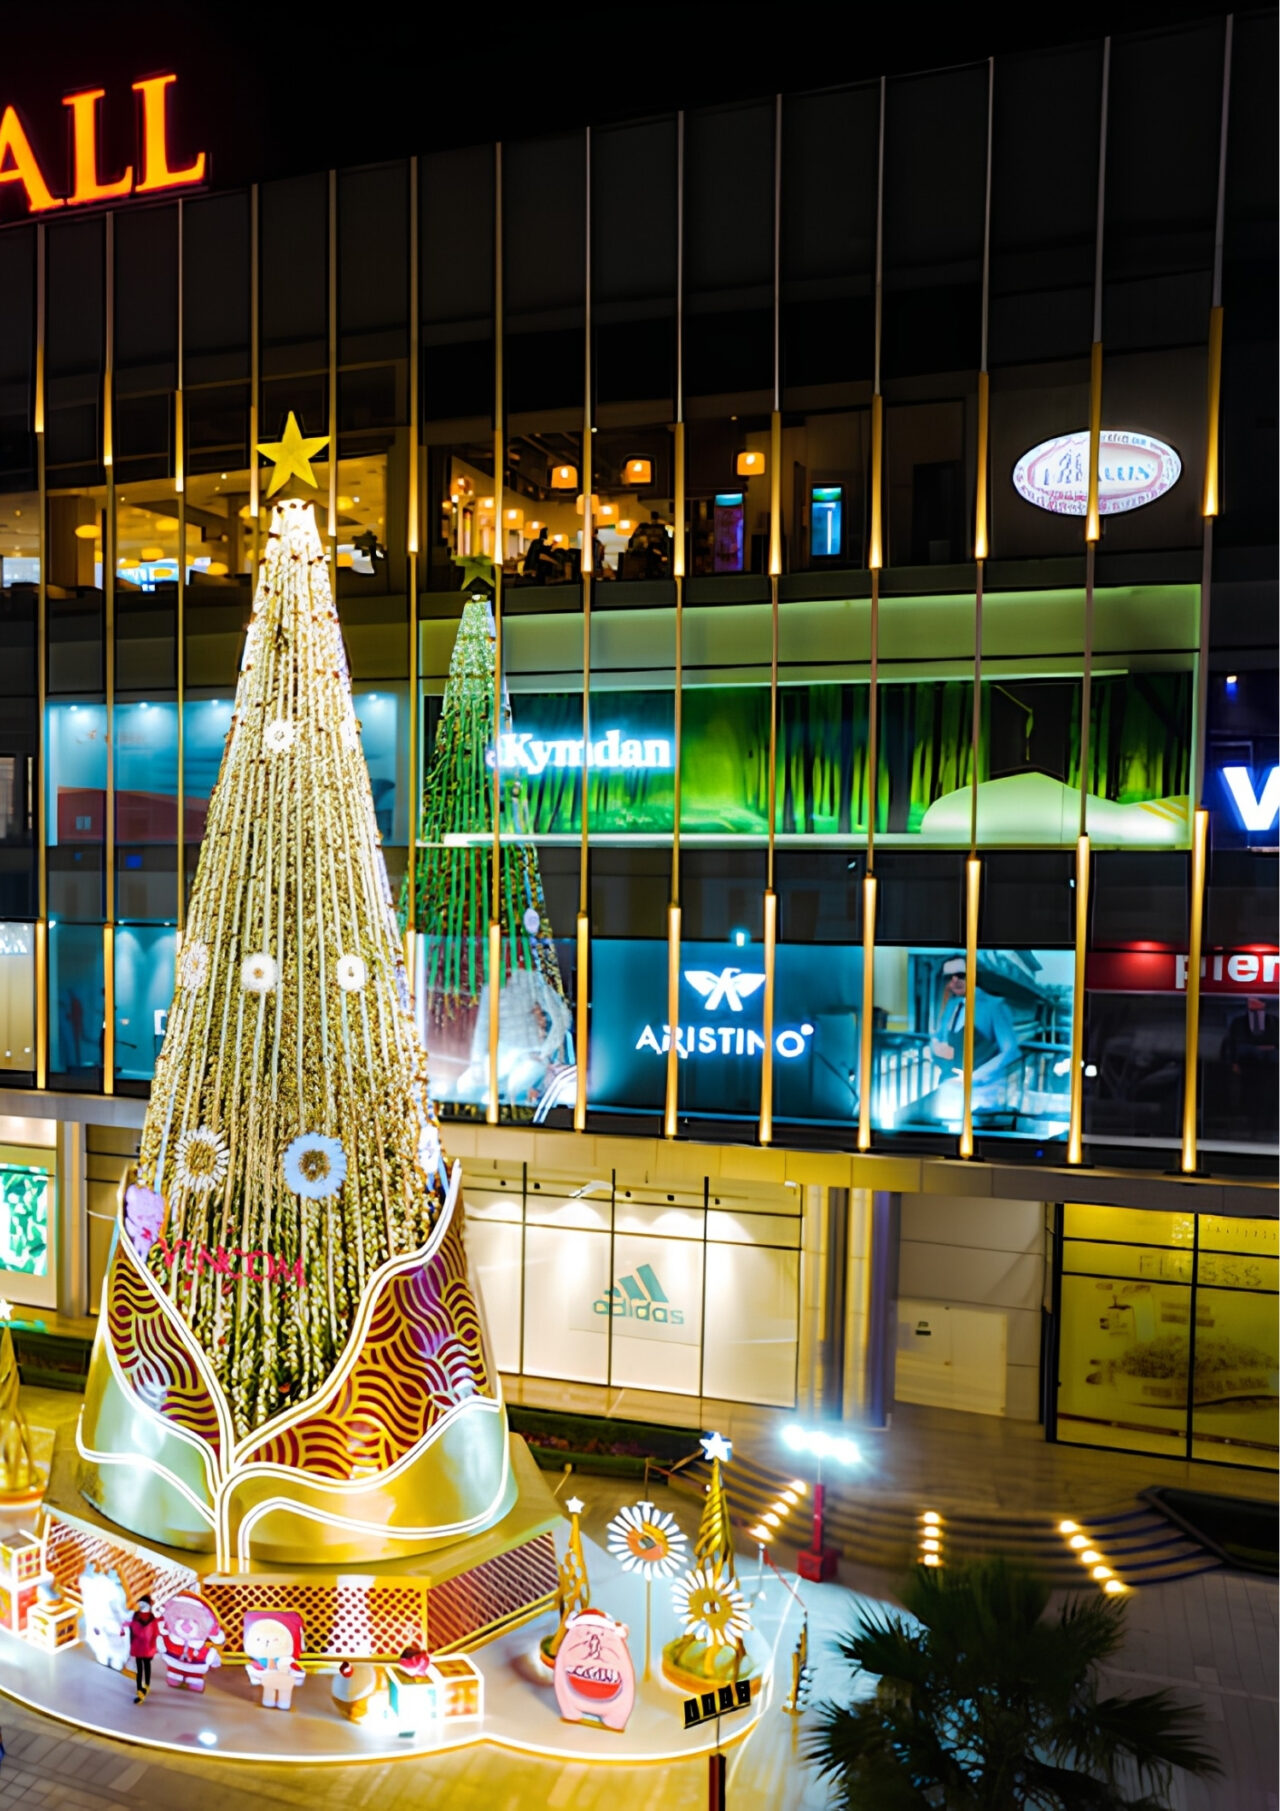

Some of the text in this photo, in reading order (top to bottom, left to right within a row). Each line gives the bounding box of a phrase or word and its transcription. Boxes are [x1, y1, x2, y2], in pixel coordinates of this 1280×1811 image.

[498, 729, 671, 775] Kymdan
[635, 1023, 807, 1059] ARISTINO
[157, 1237, 307, 1288] VINCOM
[593, 1297, 685, 1325] adidas
